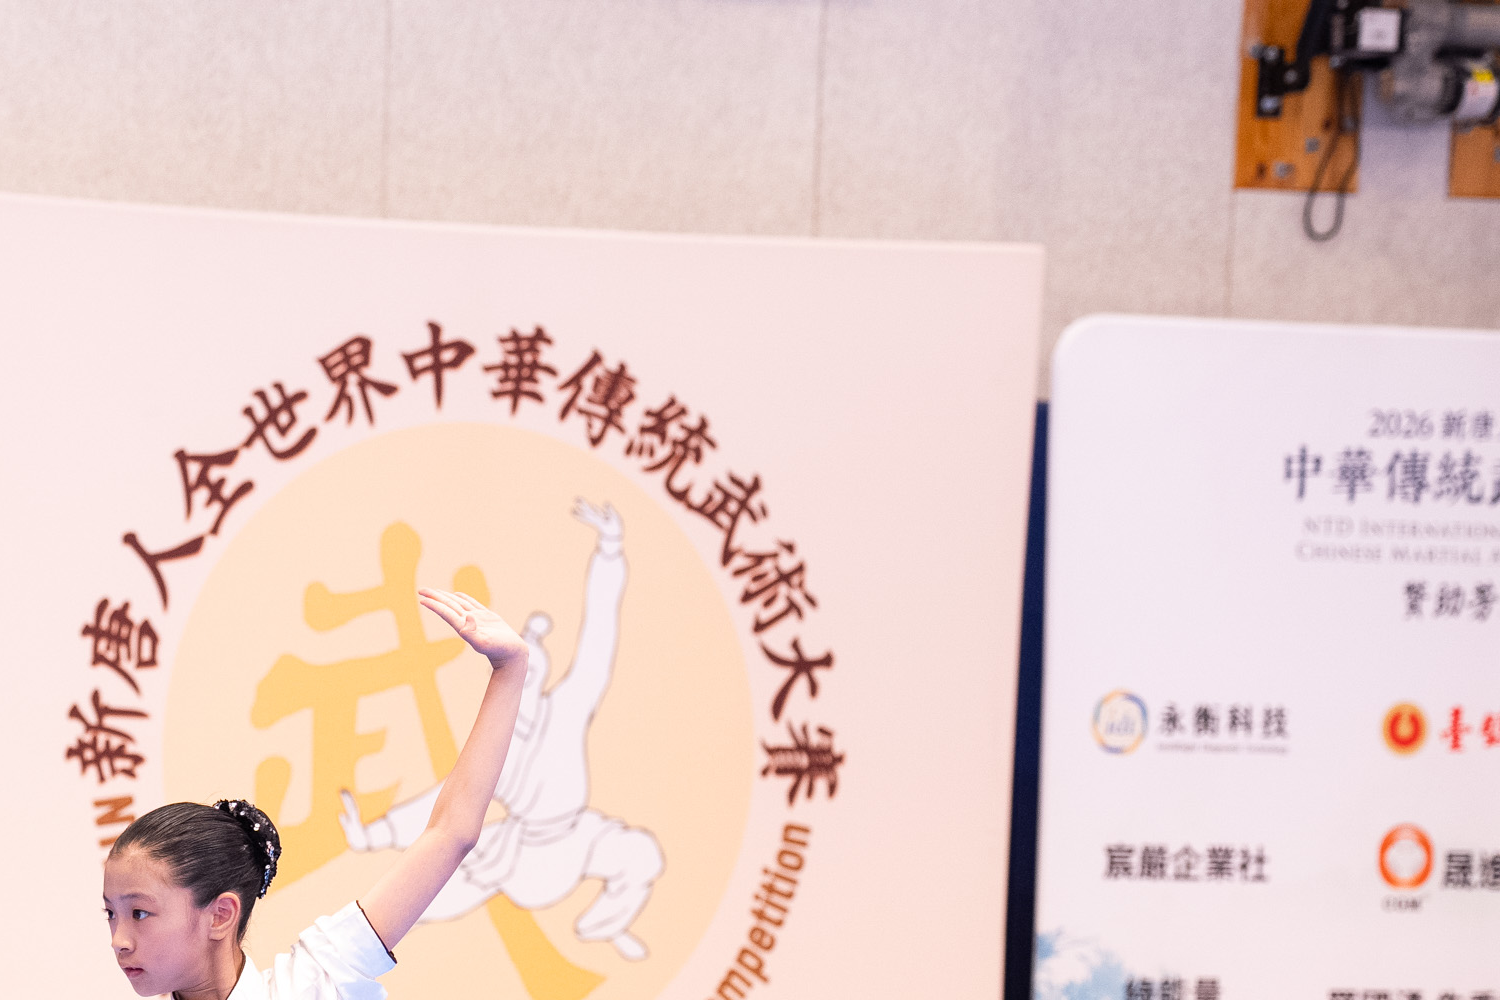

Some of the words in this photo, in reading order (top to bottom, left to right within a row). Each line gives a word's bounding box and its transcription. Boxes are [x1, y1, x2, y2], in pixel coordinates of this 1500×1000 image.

[1367, 408, 1435, 439] 2026
[1283, 443, 1500, 505] 中華傳統
[66, 320, 846, 807] 新唐人全世界中華傳統武術大賽
